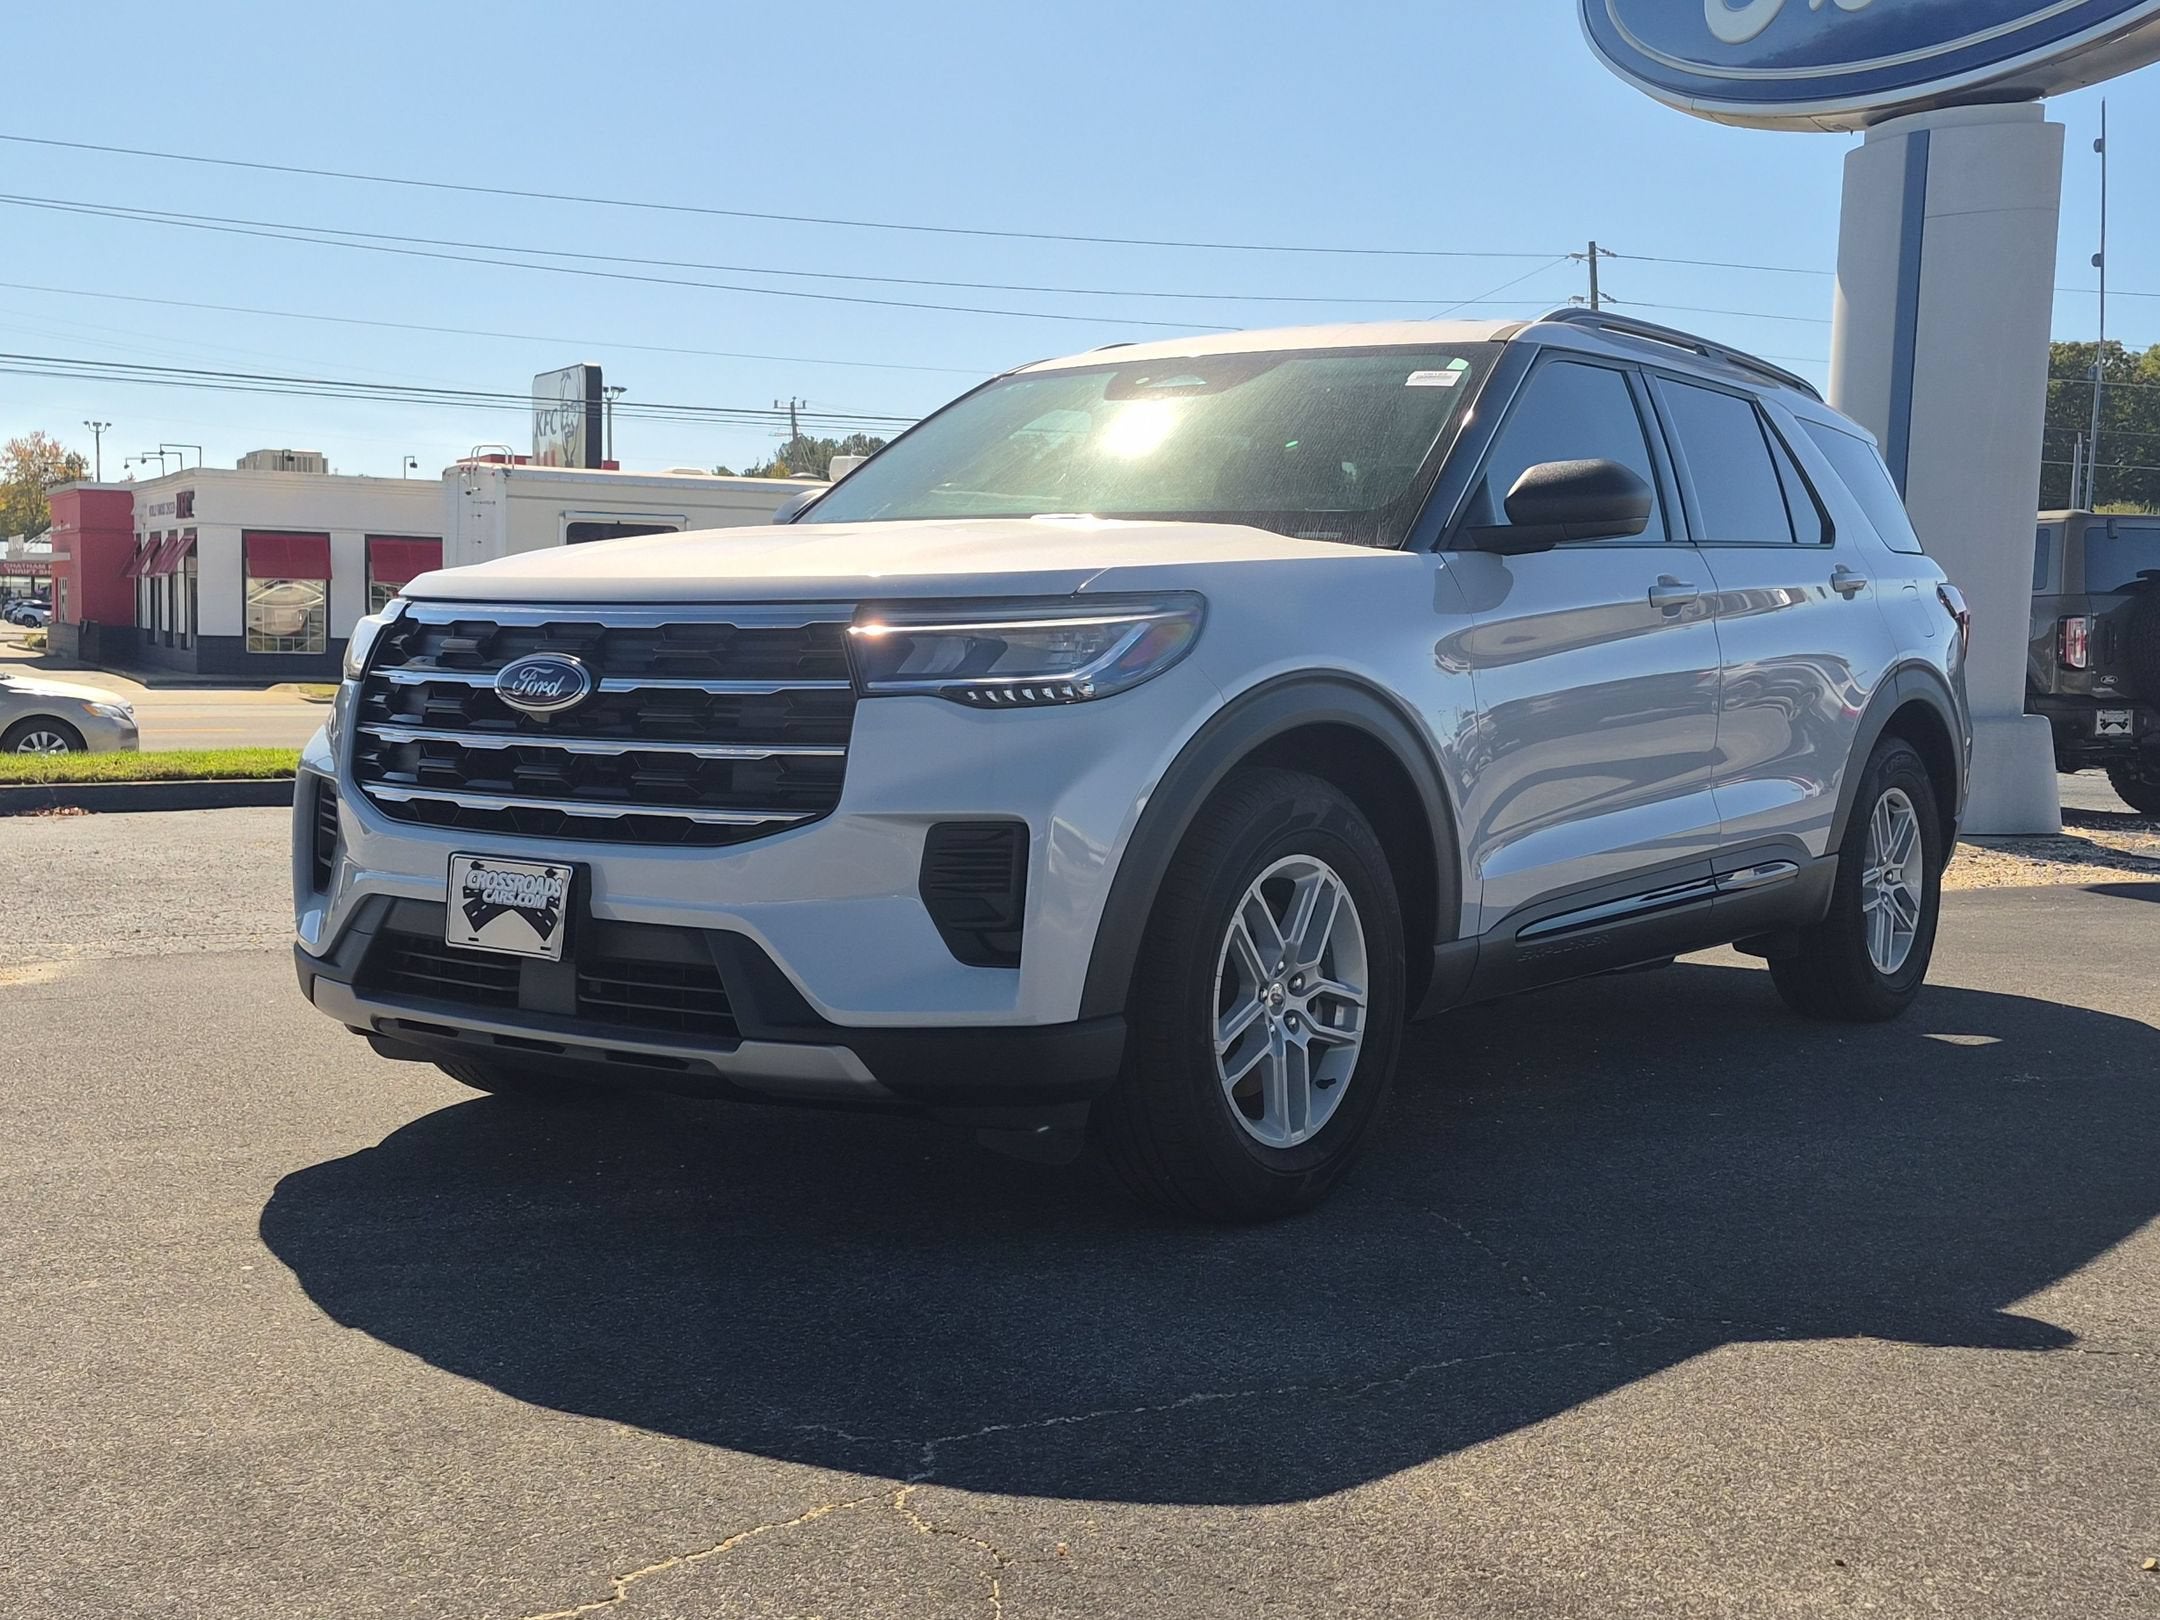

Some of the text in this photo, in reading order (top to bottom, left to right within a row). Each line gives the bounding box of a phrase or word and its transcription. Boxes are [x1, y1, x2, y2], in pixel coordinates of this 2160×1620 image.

[535, 408, 557, 438] KFC
[513, 666, 565, 697] Ford
[465, 869, 562, 898] CROSSROADS
[482, 888, 549, 910] CARS.COM
